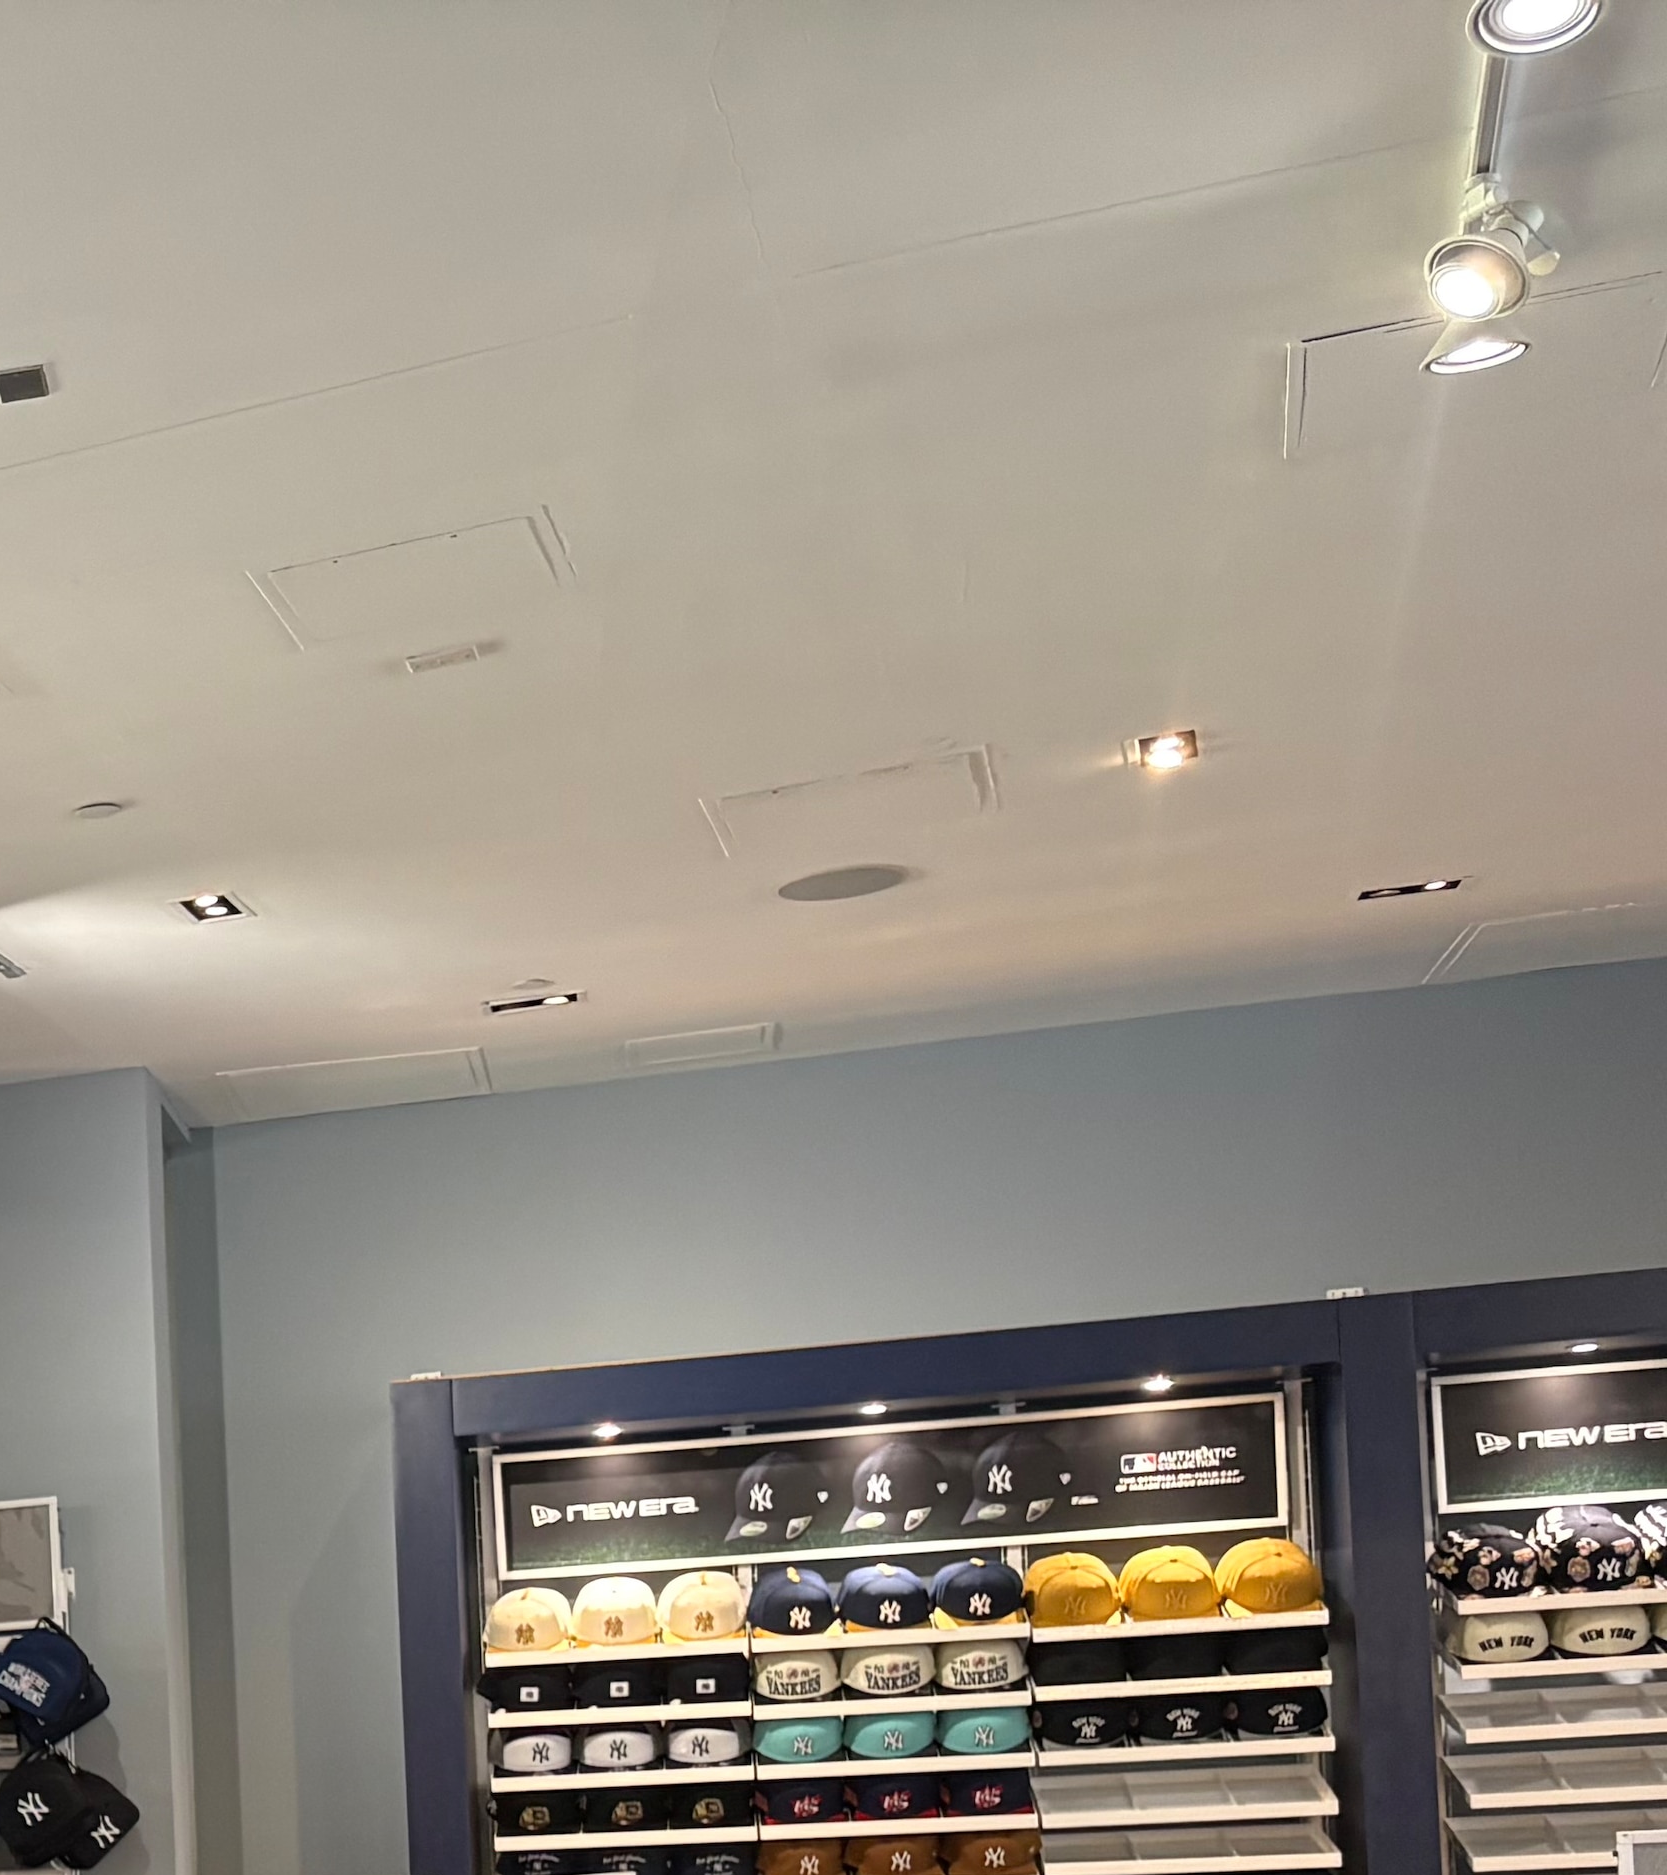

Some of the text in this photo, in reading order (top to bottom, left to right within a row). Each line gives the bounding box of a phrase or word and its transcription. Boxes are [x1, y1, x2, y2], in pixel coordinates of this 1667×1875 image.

[1158, 1446, 1236, 1463] AUTHENTIC
[1478, 1635, 1535, 1652] NEW YORK
[1579, 1627, 1636, 1643] NEW YORK
[865, 1666, 920, 1691] YANKEES
[951, 1660, 1009, 1686] YANKEES
[767, 1674, 821, 1697] YANKEES
